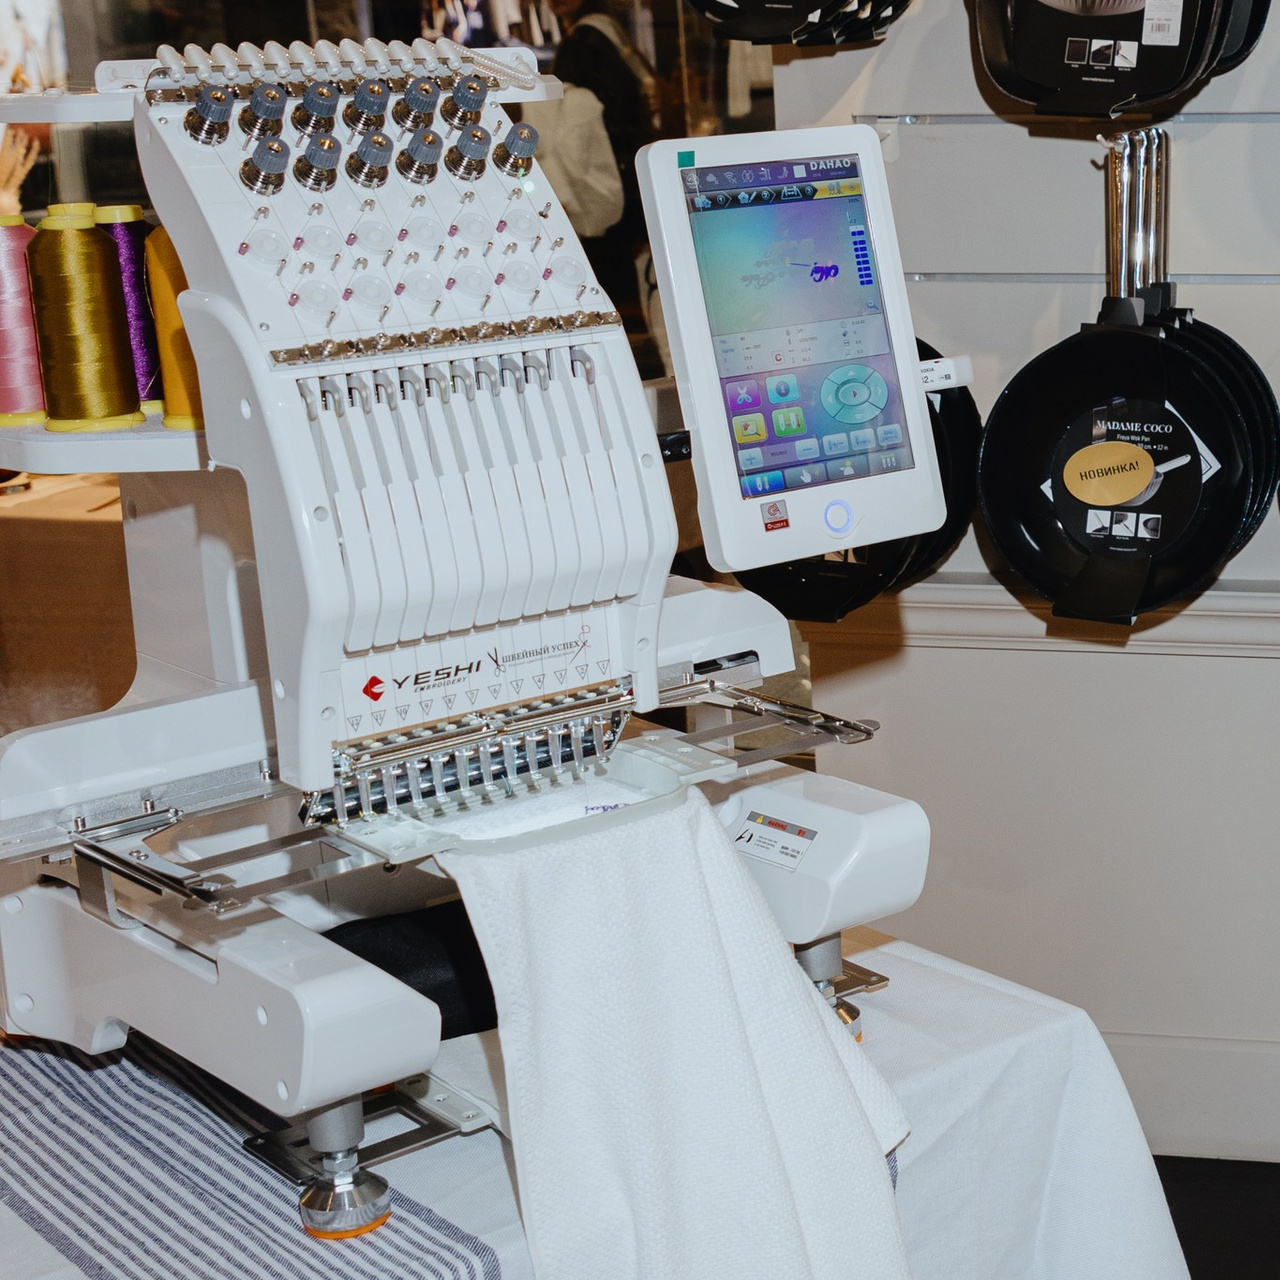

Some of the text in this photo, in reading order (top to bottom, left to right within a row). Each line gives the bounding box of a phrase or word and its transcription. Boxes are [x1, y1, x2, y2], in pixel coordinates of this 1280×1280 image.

[809, 158, 851, 170] DAHAO
[774, 353, 782, 362] C
[1096, 420, 1173, 434] MADAME COCO
[1079, 460, 1140, 481] НОВИНКА!
[501, 645, 550, 664] ШВЕЙНЫЙ
[551, 639, 580, 653] УСПЕХ
[392, 660, 481, 688] YESHI
[414, 676, 467, 693] EMBROIDERY
